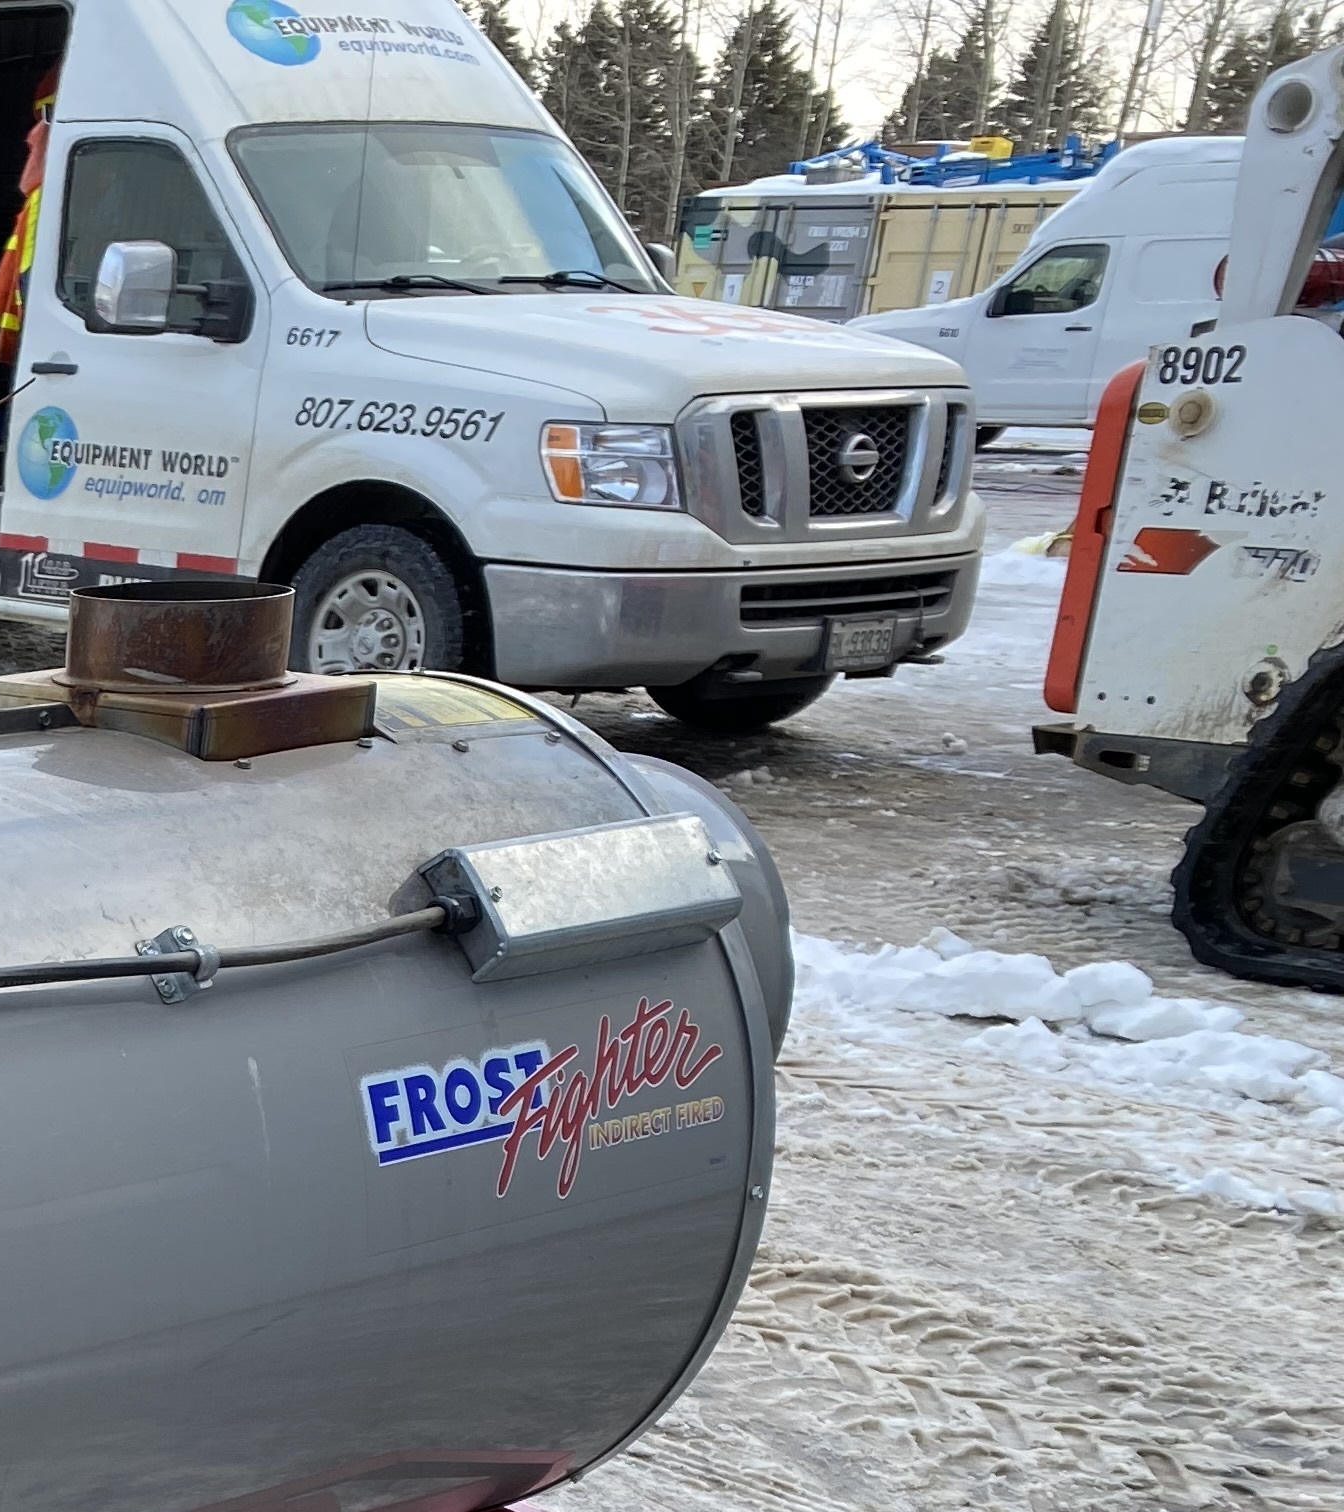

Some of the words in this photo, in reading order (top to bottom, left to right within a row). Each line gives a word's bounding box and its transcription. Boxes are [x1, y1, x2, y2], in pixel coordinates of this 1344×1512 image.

[273, 15, 395, 36] EQUIPMENT
[398, 20, 465, 46] WORLD
[339, 39, 480, 66] equipworld.com
[286, 326, 342, 347] 6617
[1159, 344, 1247, 385] 8902
[295, 397, 506, 443] 807.623.9561
[50, 440, 153, 470] EQUIPMENT
[161, 450, 229, 478] WORLD
[85, 474, 226, 505] equipworld.om
[365, 1047, 546, 1146] FROST
[496, 996, 723, 1199] Fighter
[589, 1109, 672, 1150] INDIRECT
[676, 1096, 725, 1133] FIRED
